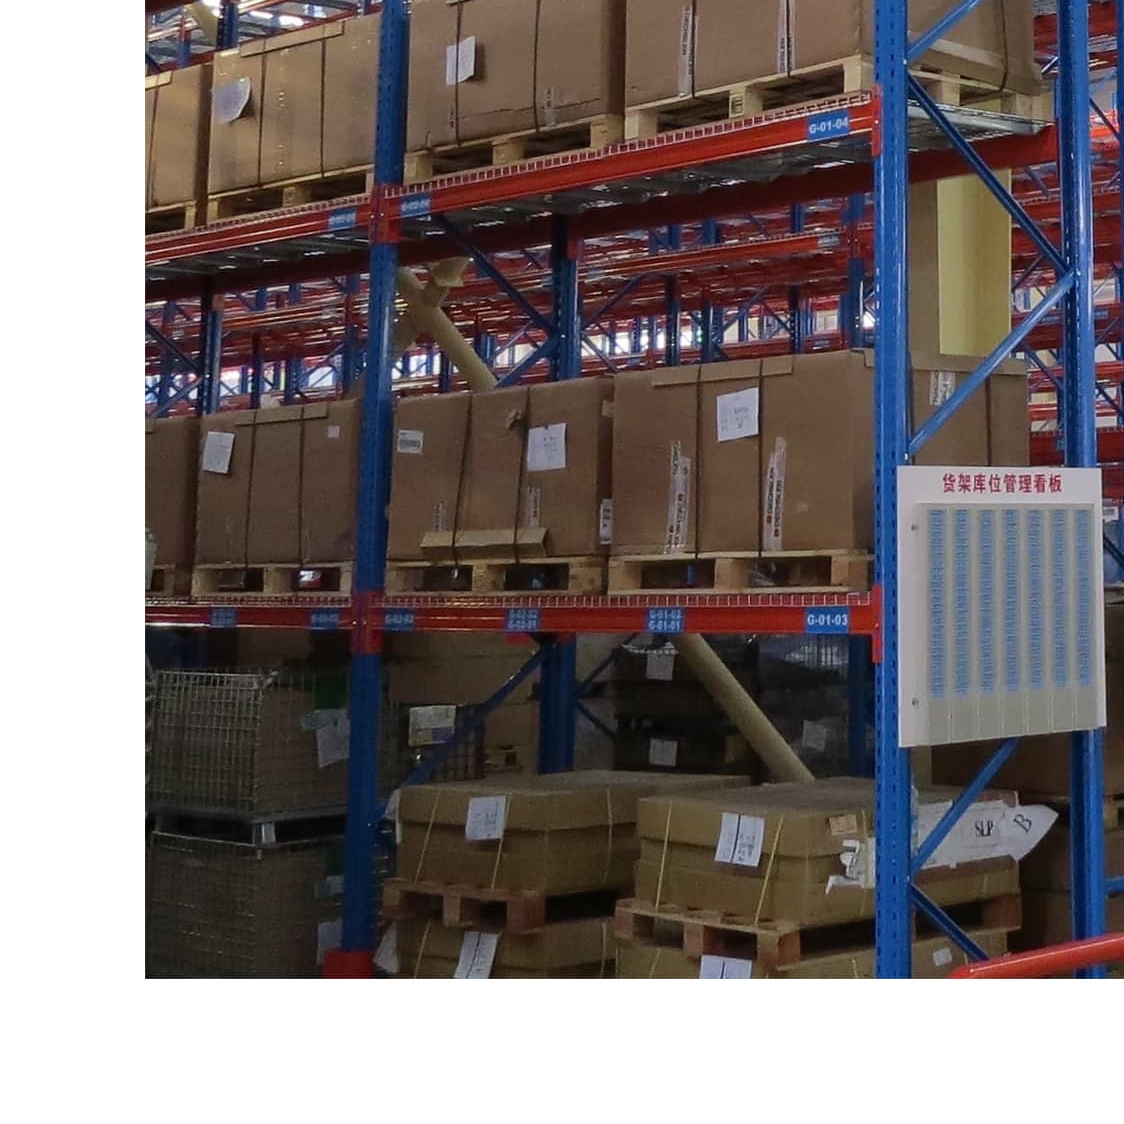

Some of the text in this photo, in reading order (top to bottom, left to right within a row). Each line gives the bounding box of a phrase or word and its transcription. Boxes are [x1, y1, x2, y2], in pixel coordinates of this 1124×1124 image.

[809, 116, 848, 134] G-01-04
[943, 473, 1062, 493] 货架库位管理看板
[807, 615, 848, 626] G-01-03
[975, 820, 993, 837] SLP
